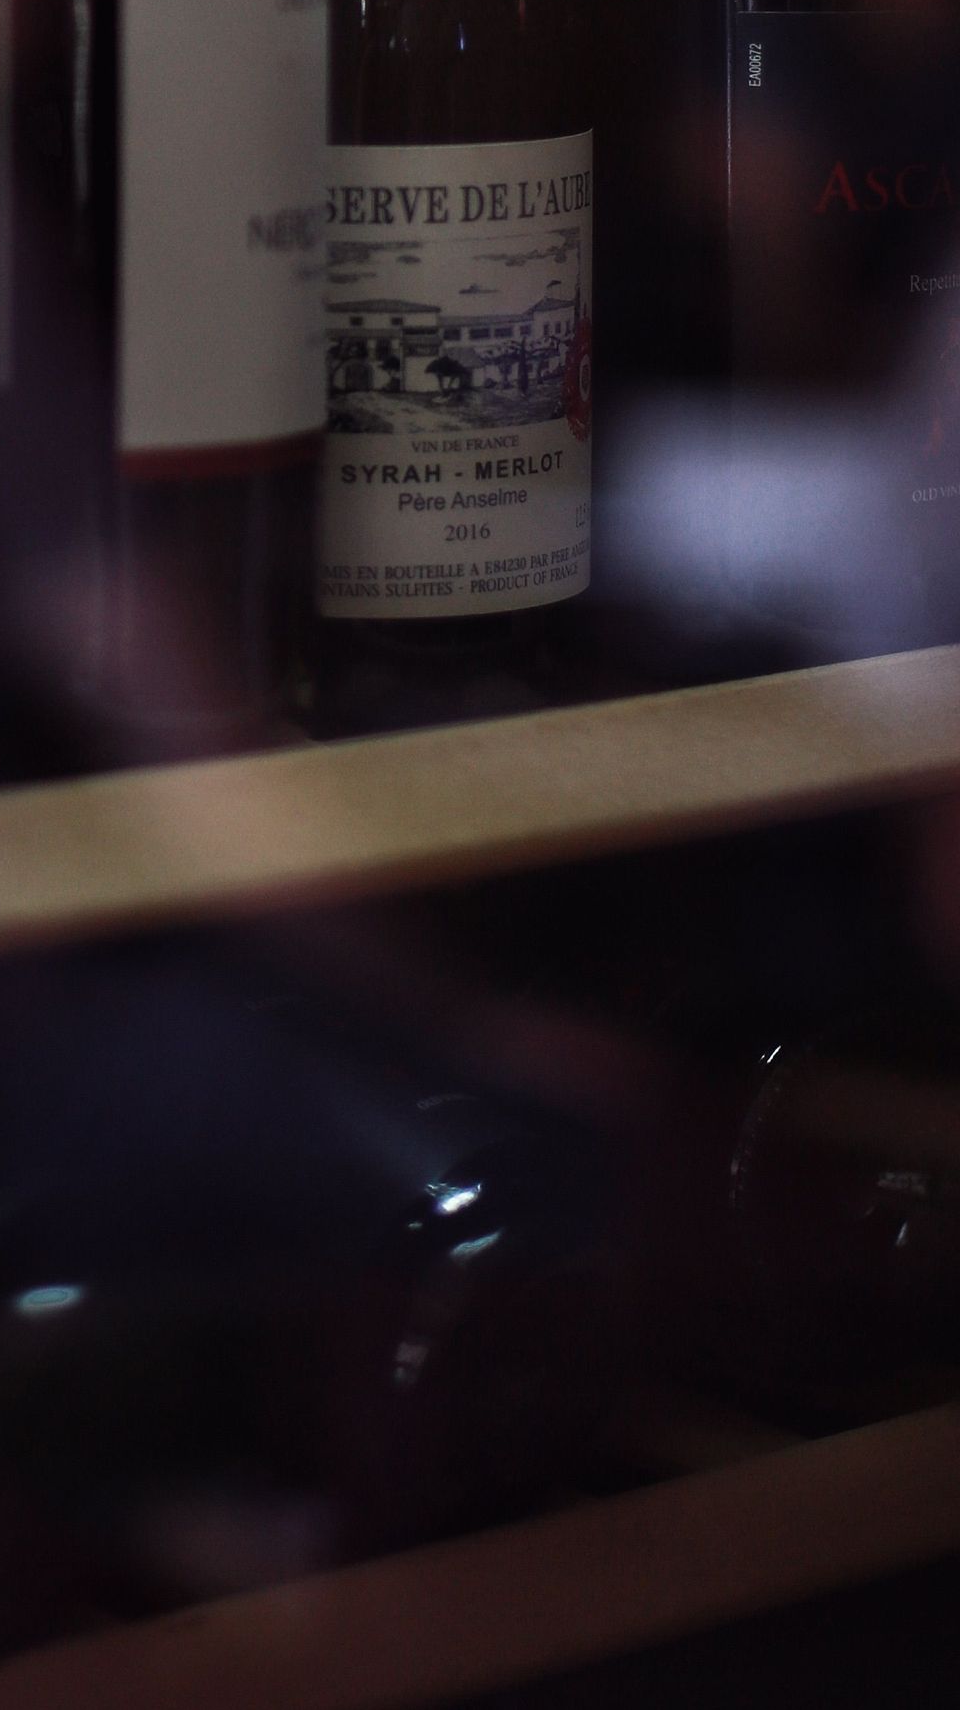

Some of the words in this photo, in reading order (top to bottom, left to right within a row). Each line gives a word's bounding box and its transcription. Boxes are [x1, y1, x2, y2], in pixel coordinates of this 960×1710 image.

[748, 43, 762, 88] EA00672
[459, 183, 509, 223] DE
[411, 439, 438, 454] VIN
[442, 438, 462, 453] DE
[465, 434, 521, 452] FRANCE
[340, 463, 441, 485] SYRAH
[474, 450, 564, 481] MERLOT
[398, 491, 446, 511] Père
[450, 488, 528, 510] Anselme
[911, 487, 938, 504] OLD
[444, 523, 491, 542] 2016
[357, 565, 378, 580] EN
[384, 563, 465, 580] BOUTEILLE
[469, 562, 480, 577] A
[530, 553, 549, 570] PAR
[385, 581, 453, 598] SULFITES
[470, 572, 529, 594] PRODUCT
[532, 570, 548, 586] OF
